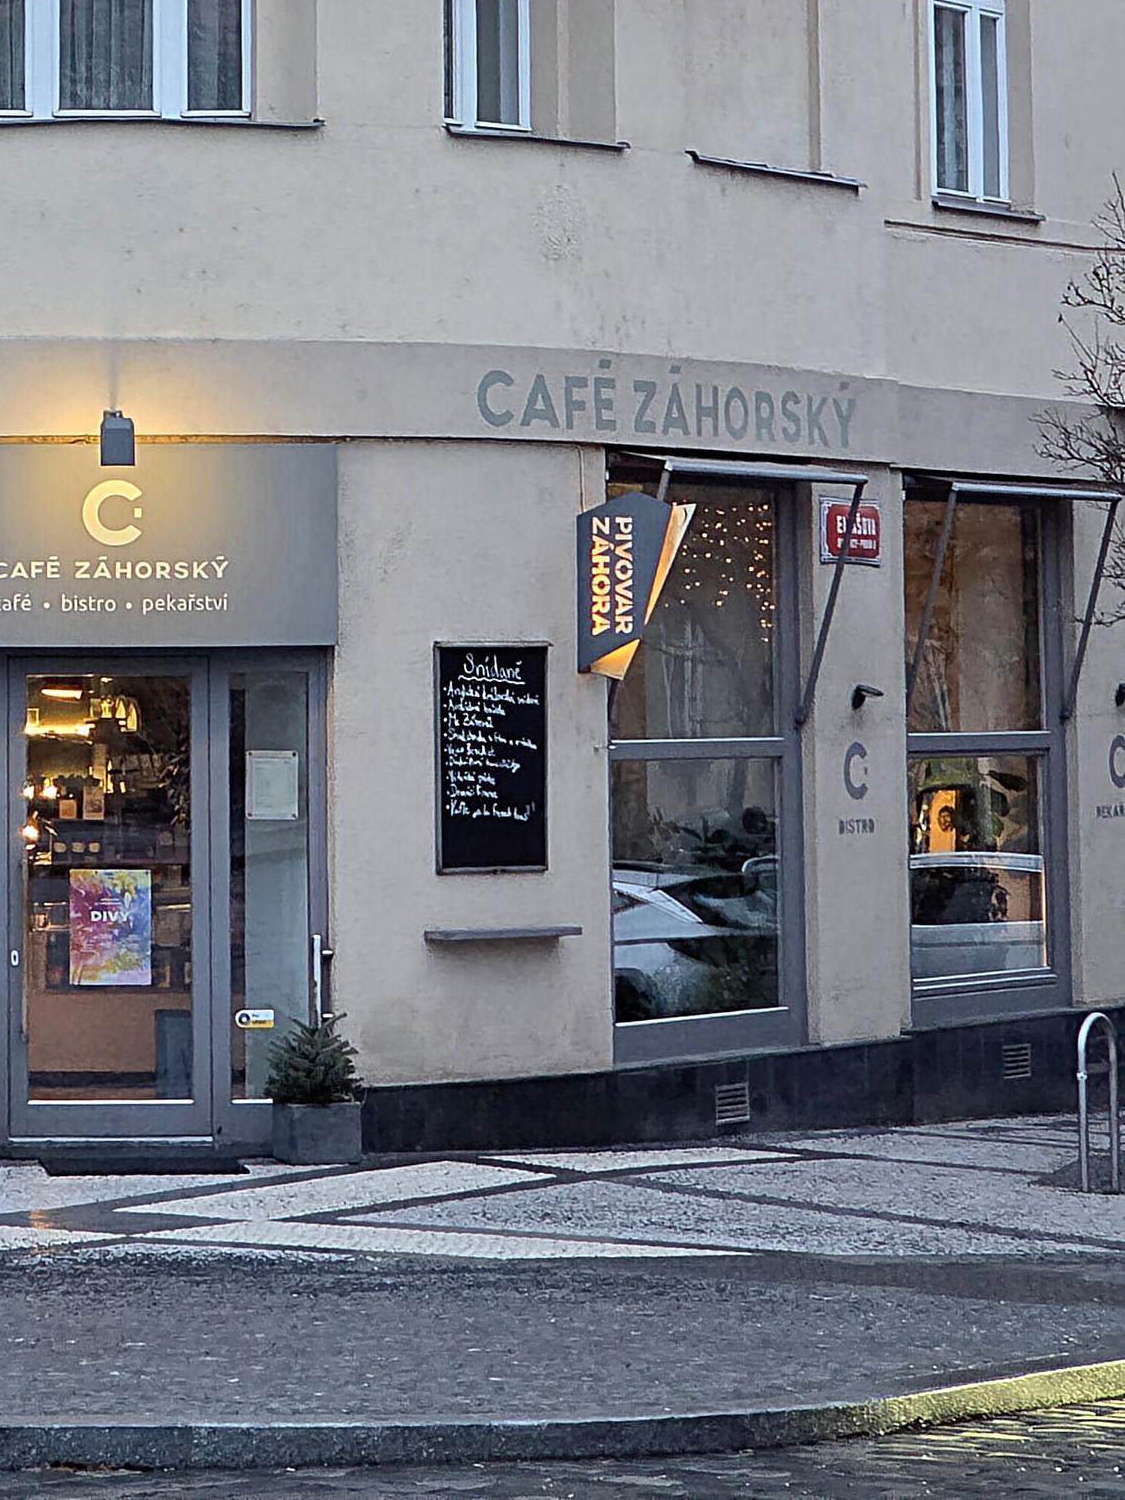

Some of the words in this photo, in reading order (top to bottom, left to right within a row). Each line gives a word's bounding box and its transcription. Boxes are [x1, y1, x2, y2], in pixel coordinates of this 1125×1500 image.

[477, 358, 617, 432] CAFÉ
[632, 365, 857, 449] ZÁHORSKÝ
[74, 555, 229, 580] ZÁHORSKÝ
[591, 516, 615, 637] ZÁHORA
[614, 515, 634, 635] PIVOVAR
[61, 593, 117, 612] bistro
[141, 592, 229, 616] pekařství
[463, 652, 523, 680] Snídaně
